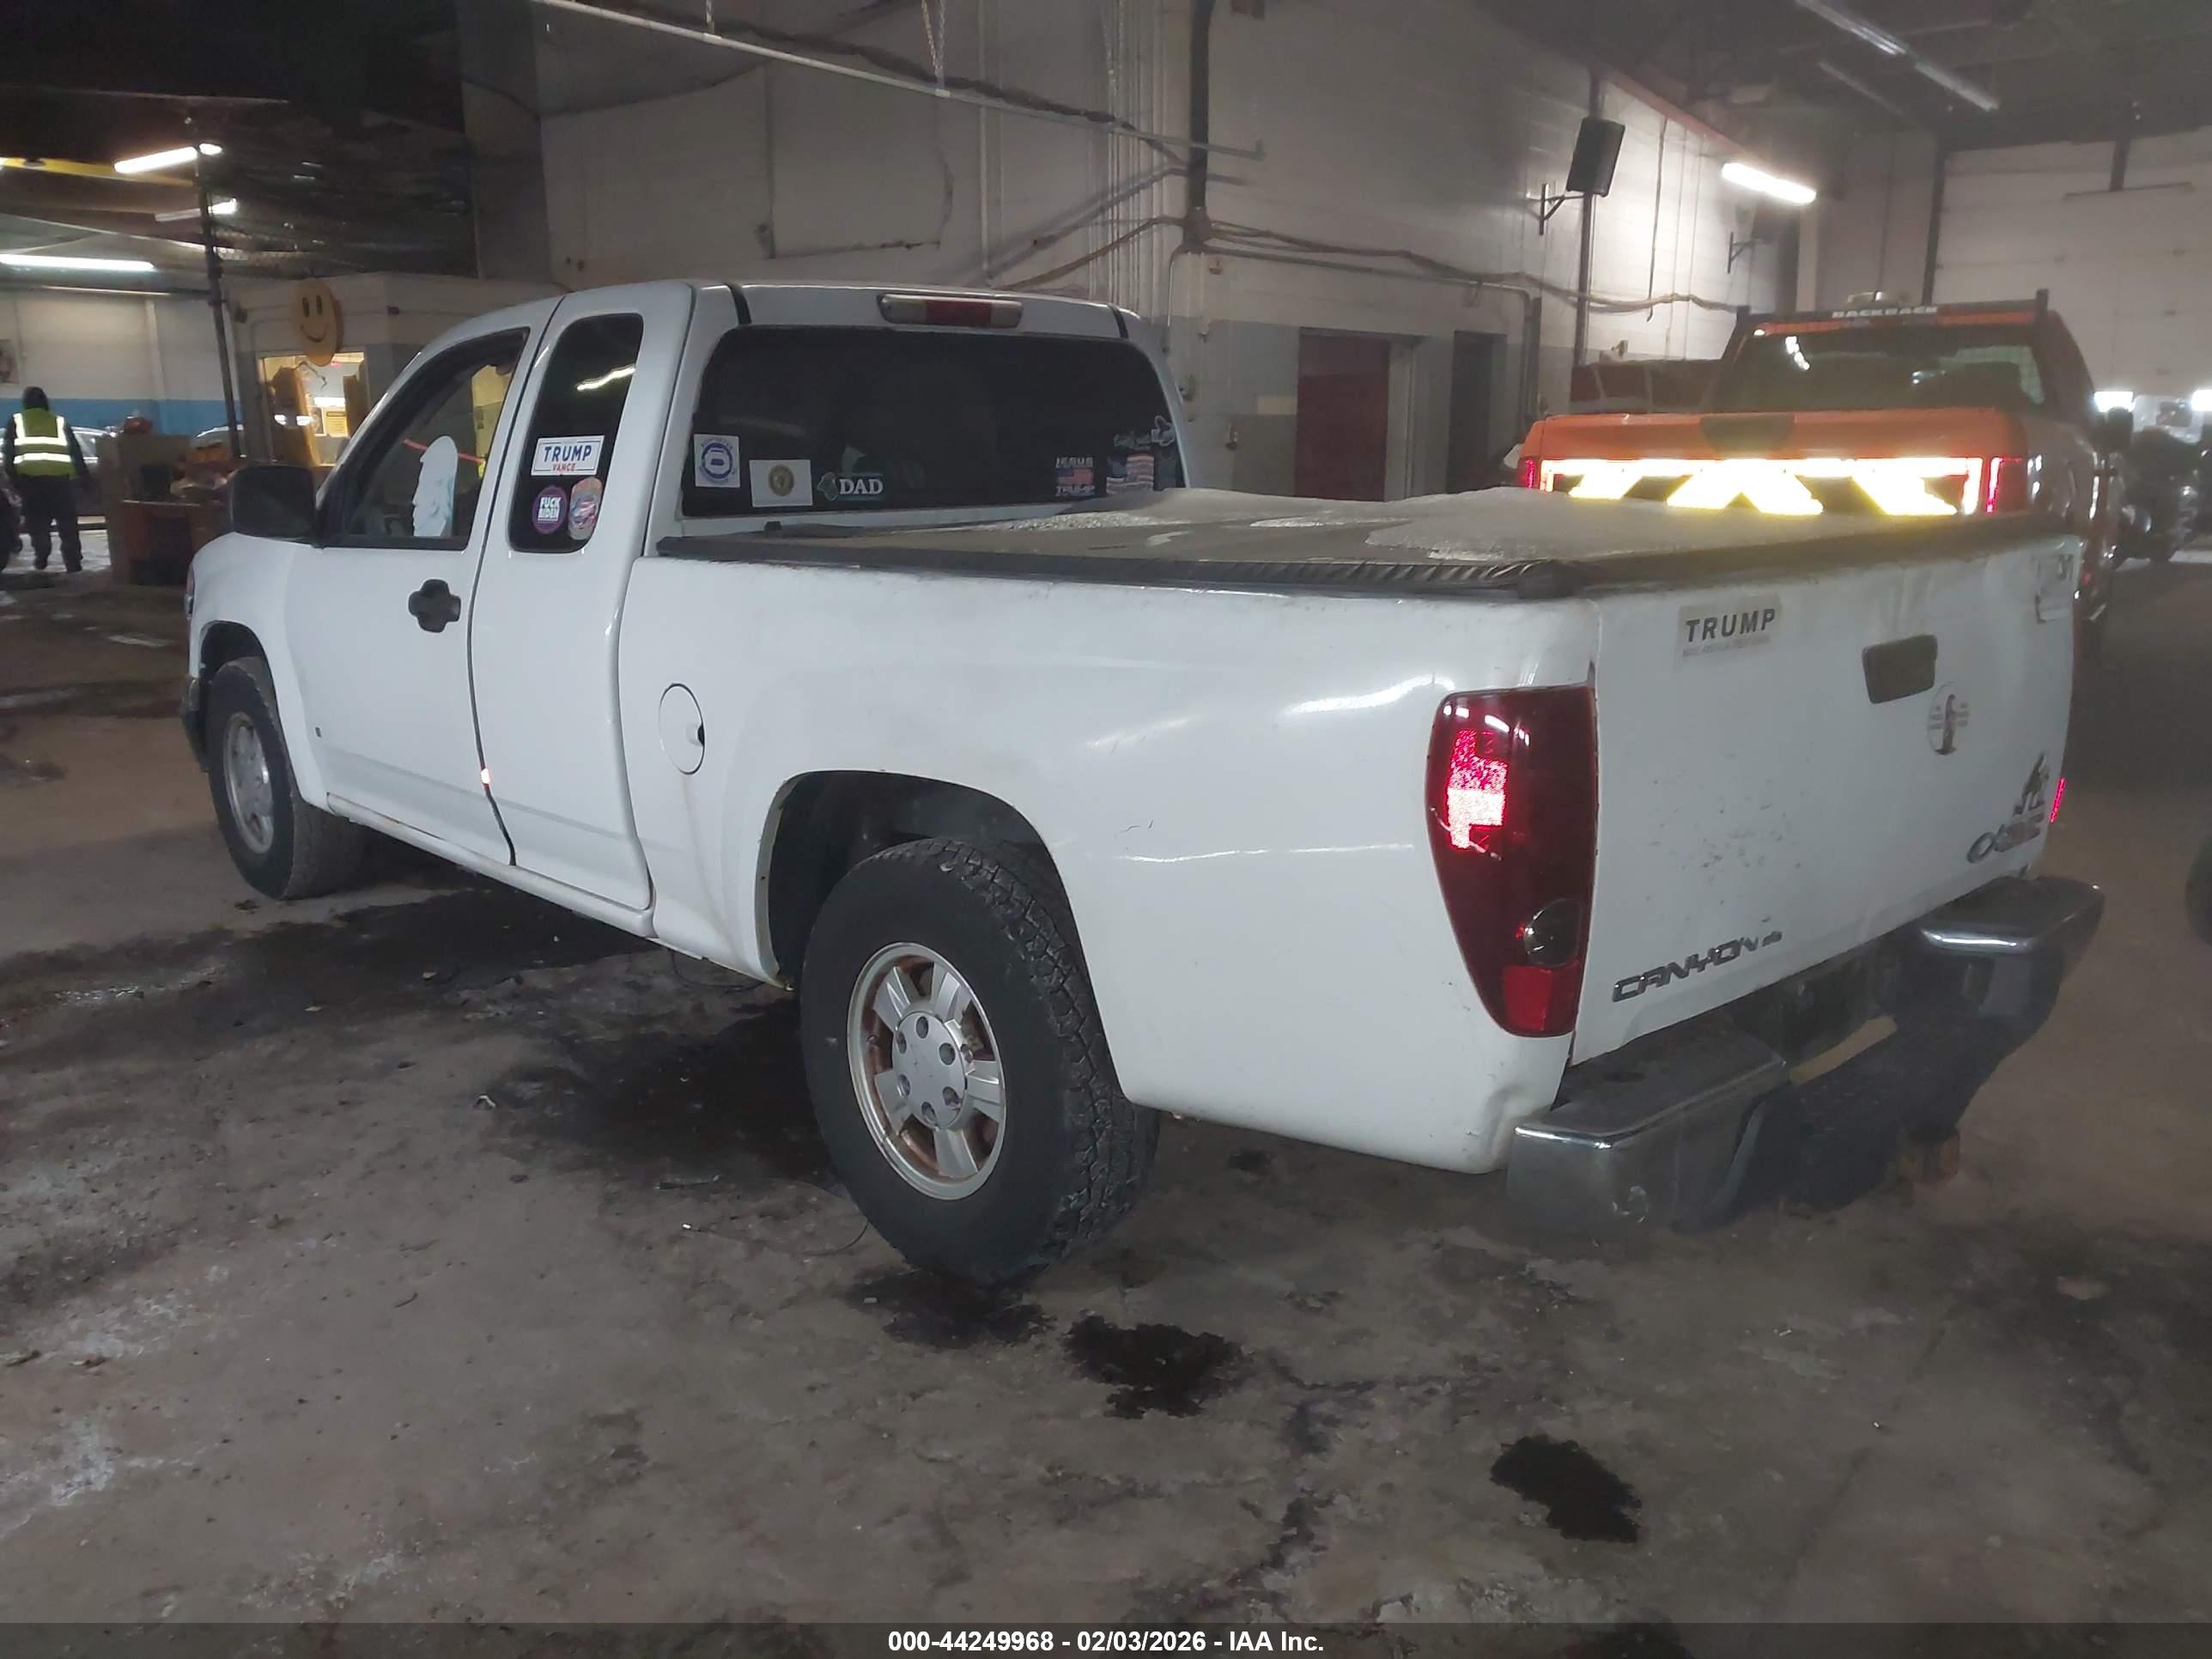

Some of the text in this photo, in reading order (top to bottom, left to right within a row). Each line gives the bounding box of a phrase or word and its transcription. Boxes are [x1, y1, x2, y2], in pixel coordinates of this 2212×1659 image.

[544, 445, 592, 462] TRUMP
[551, 462, 576, 471] VANCE
[1055, 457, 1093, 468] JESUS
[840, 478, 884, 495] DAD
[540, 496, 562, 508] FUCK
[538, 507, 560, 519] BIDEN
[1686, 608, 1775, 642] TRUMP
[1612, 936, 1759, 1002] CANYON
